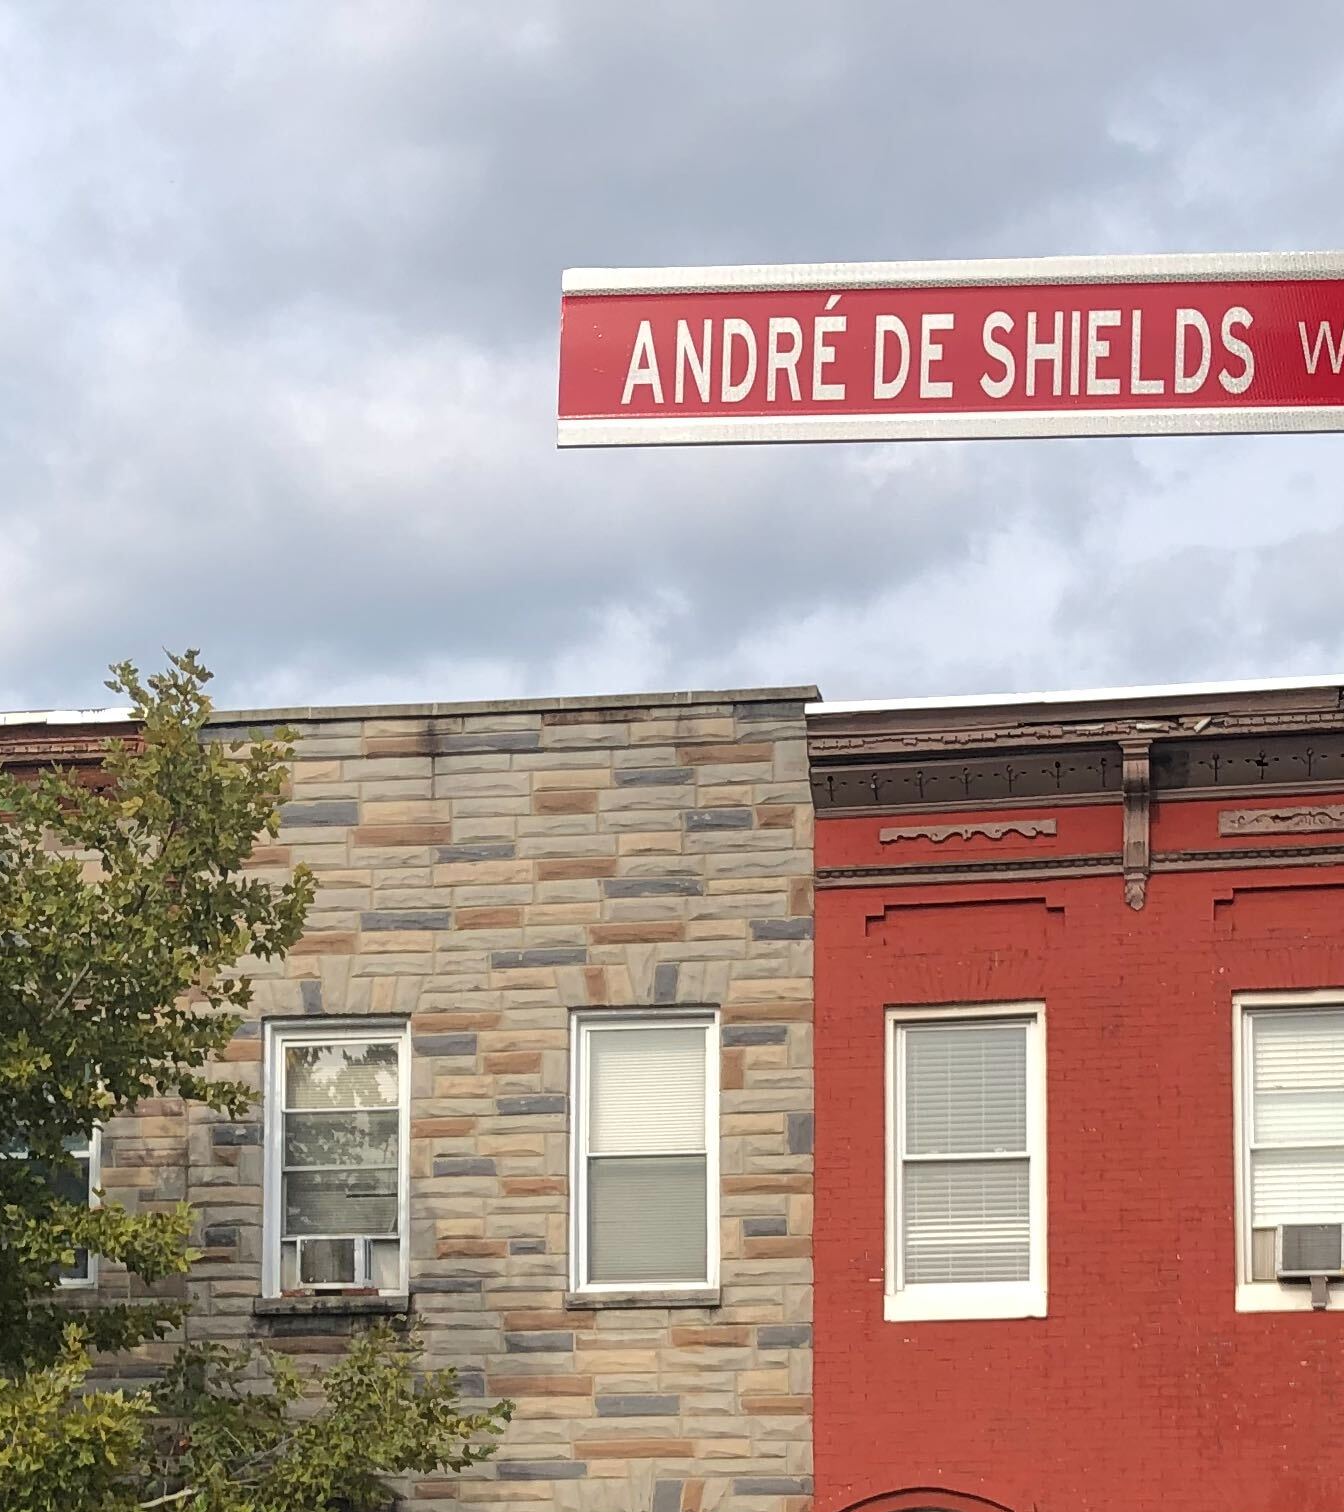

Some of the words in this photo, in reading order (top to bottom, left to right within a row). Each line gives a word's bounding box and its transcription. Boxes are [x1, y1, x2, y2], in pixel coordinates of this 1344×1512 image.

[620, 294, 848, 406] ANDRÉ
[873, 311, 956, 400] DE
[980, 305, 1256, 399] SHIELDS
